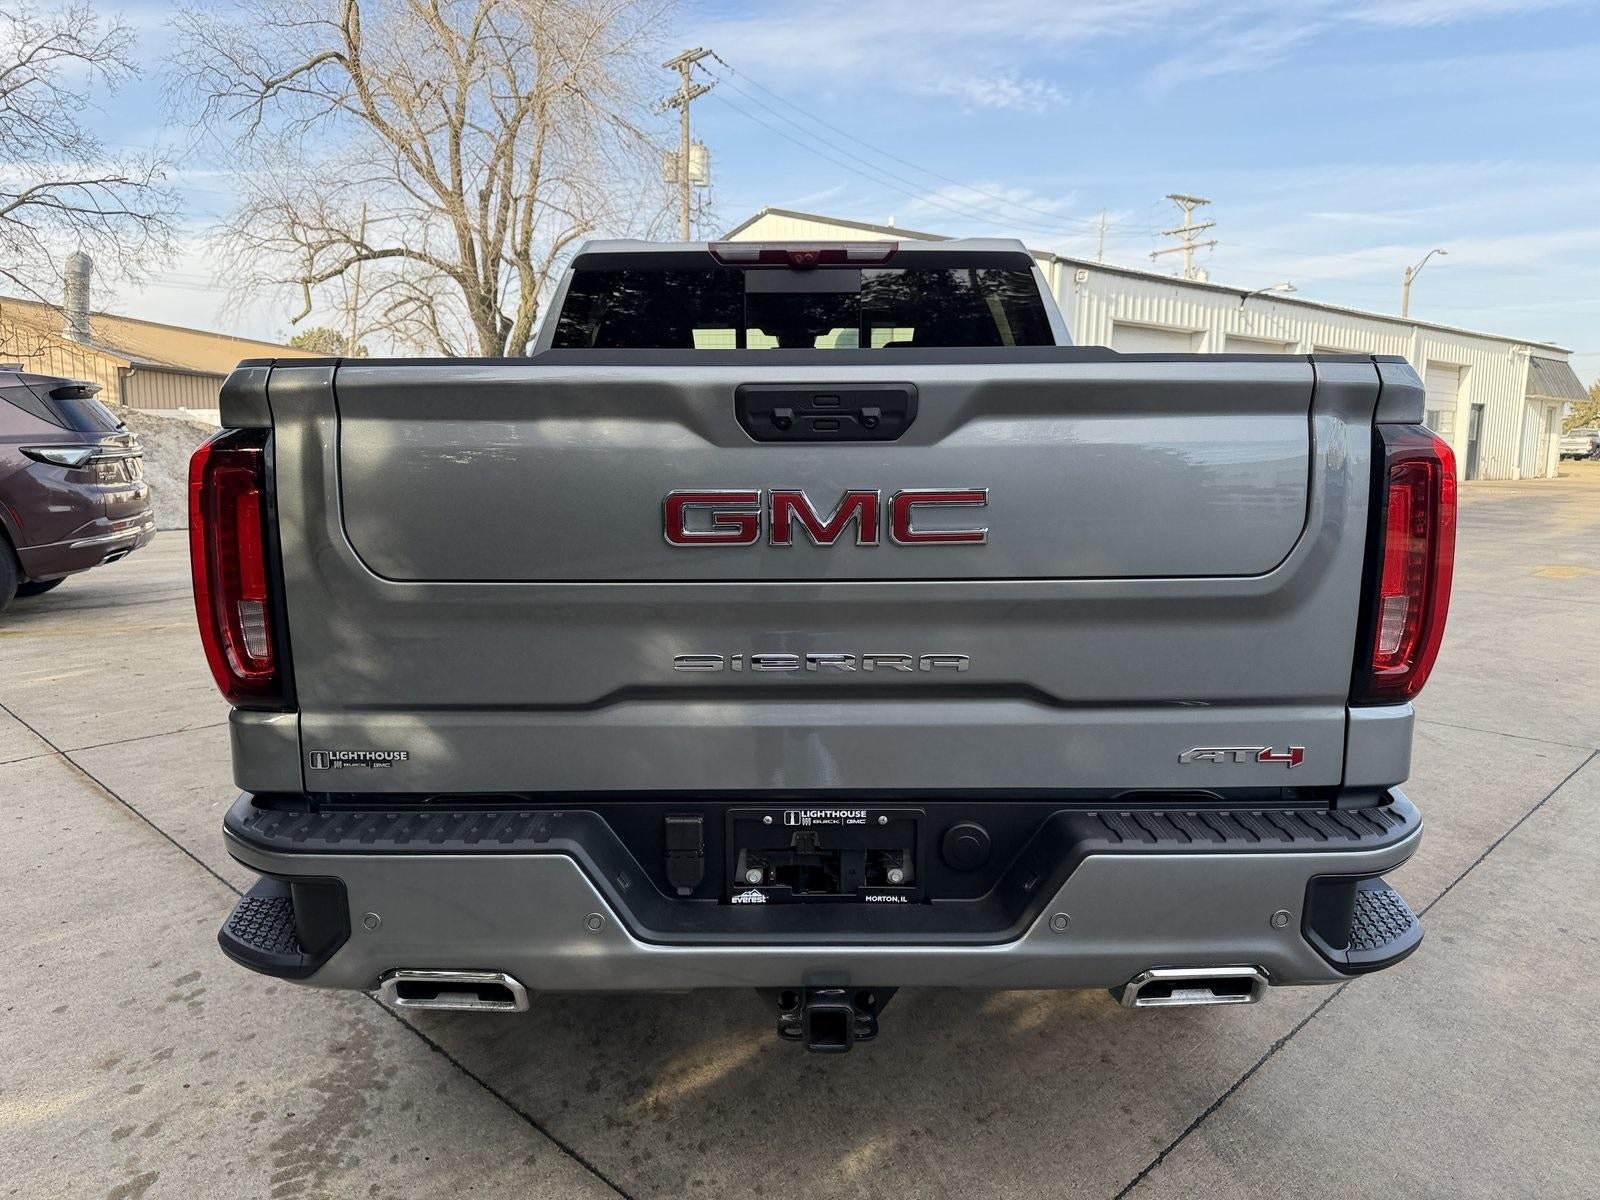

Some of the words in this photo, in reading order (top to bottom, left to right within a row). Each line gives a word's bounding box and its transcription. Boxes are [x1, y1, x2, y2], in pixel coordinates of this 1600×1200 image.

[662, 488, 990, 547] GMC
[673, 653, 971, 673] SIERRA
[329, 751, 408, 761] LIGHTHOUSE
[1179, 746, 1306, 769] AT4
[801, 810, 867, 818] LIGHTHOUSE
